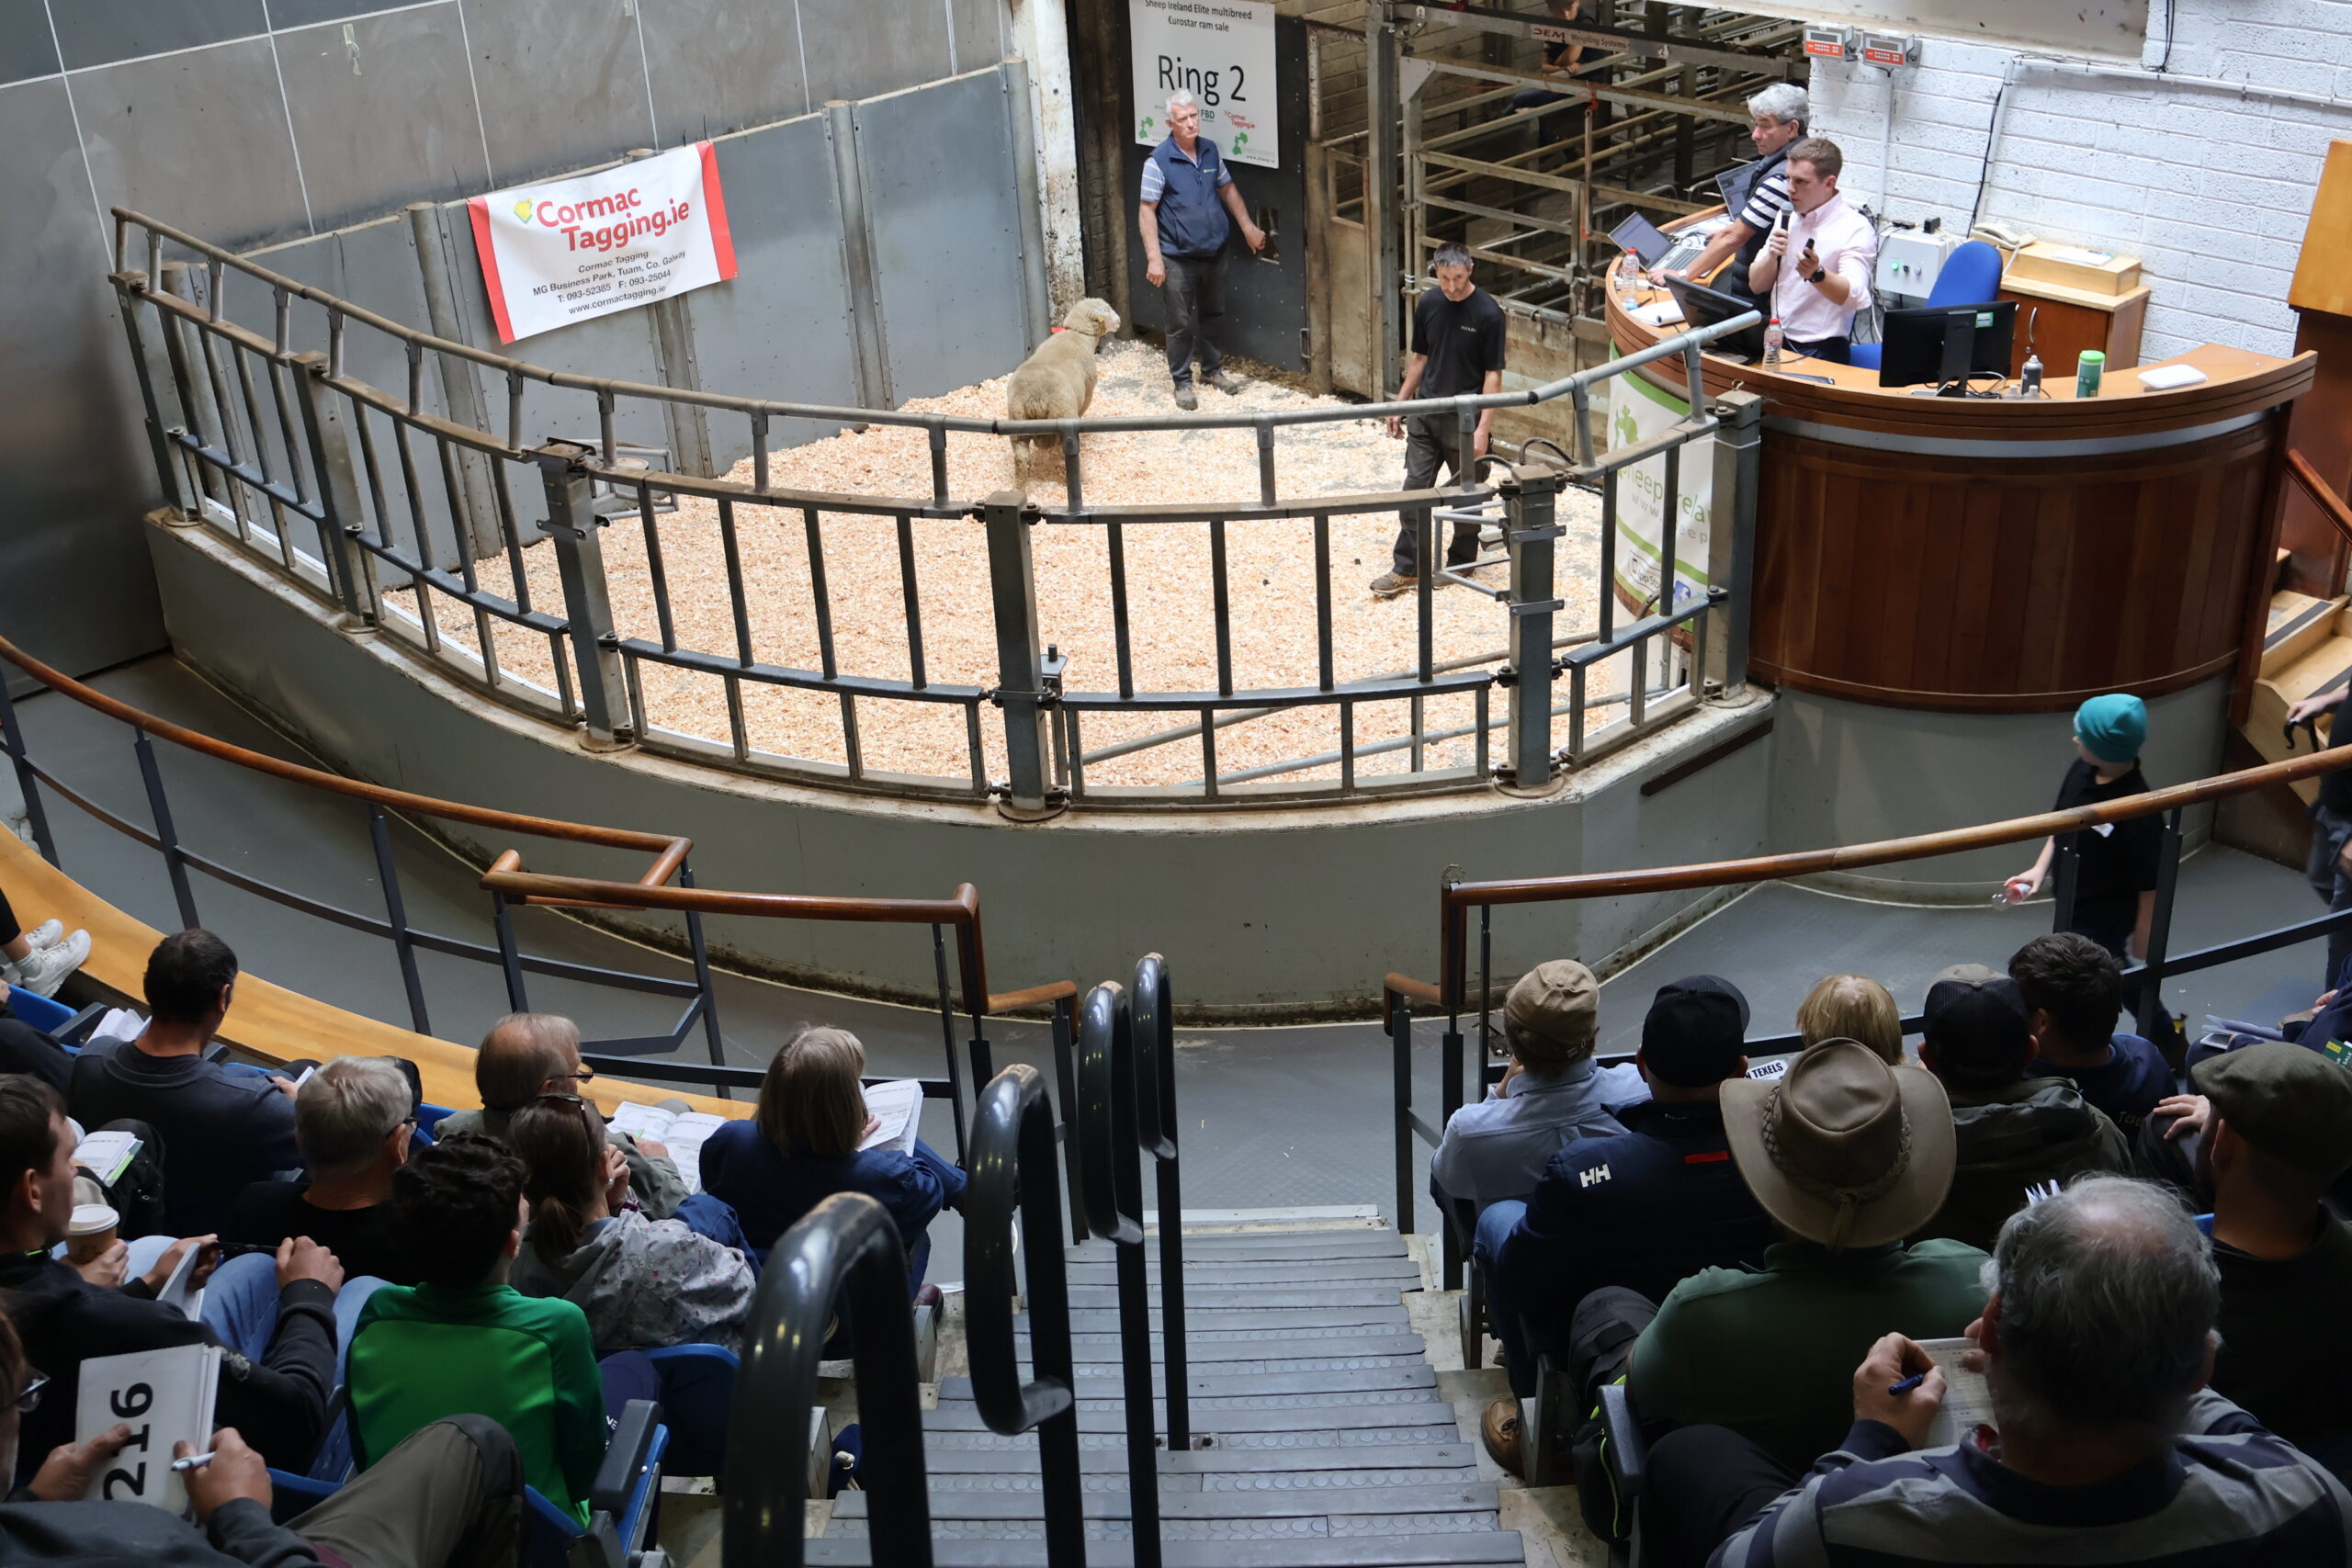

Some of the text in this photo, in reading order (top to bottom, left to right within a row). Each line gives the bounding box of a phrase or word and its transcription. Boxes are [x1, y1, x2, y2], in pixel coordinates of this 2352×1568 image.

[1168, 2, 1193, 12] Ireland
[1193, 4, 1210, 15] Elite
[1211, 7, 1252, 19] multibreed
[1199, 21, 1213, 29] ram
[1215, 22, 1229, 31] sale
[1533, 28, 1566, 39] DEM
[1159, 55, 1246, 106] Ring 2
[1201, 109, 1215, 119] FBD
[537, 188, 641, 227] Cormac
[560, 198, 689, 252] Tagging.ie
[533, 250, 686, 296] MG Business Park, Tuam, Co. Galway
[578, 251, 650, 273] Cormac Tagging
[557, 269, 672, 303] T: 093-52385 F: 093-25044
[569, 285, 666, 314] www.cormactagging.ie
[1623, 465, 1663, 503] heep
[1752, 1062, 1783, 1078] TEXELS
[1579, 1163, 1611, 1188] HH
[103, 1382, 153, 1501] 216
